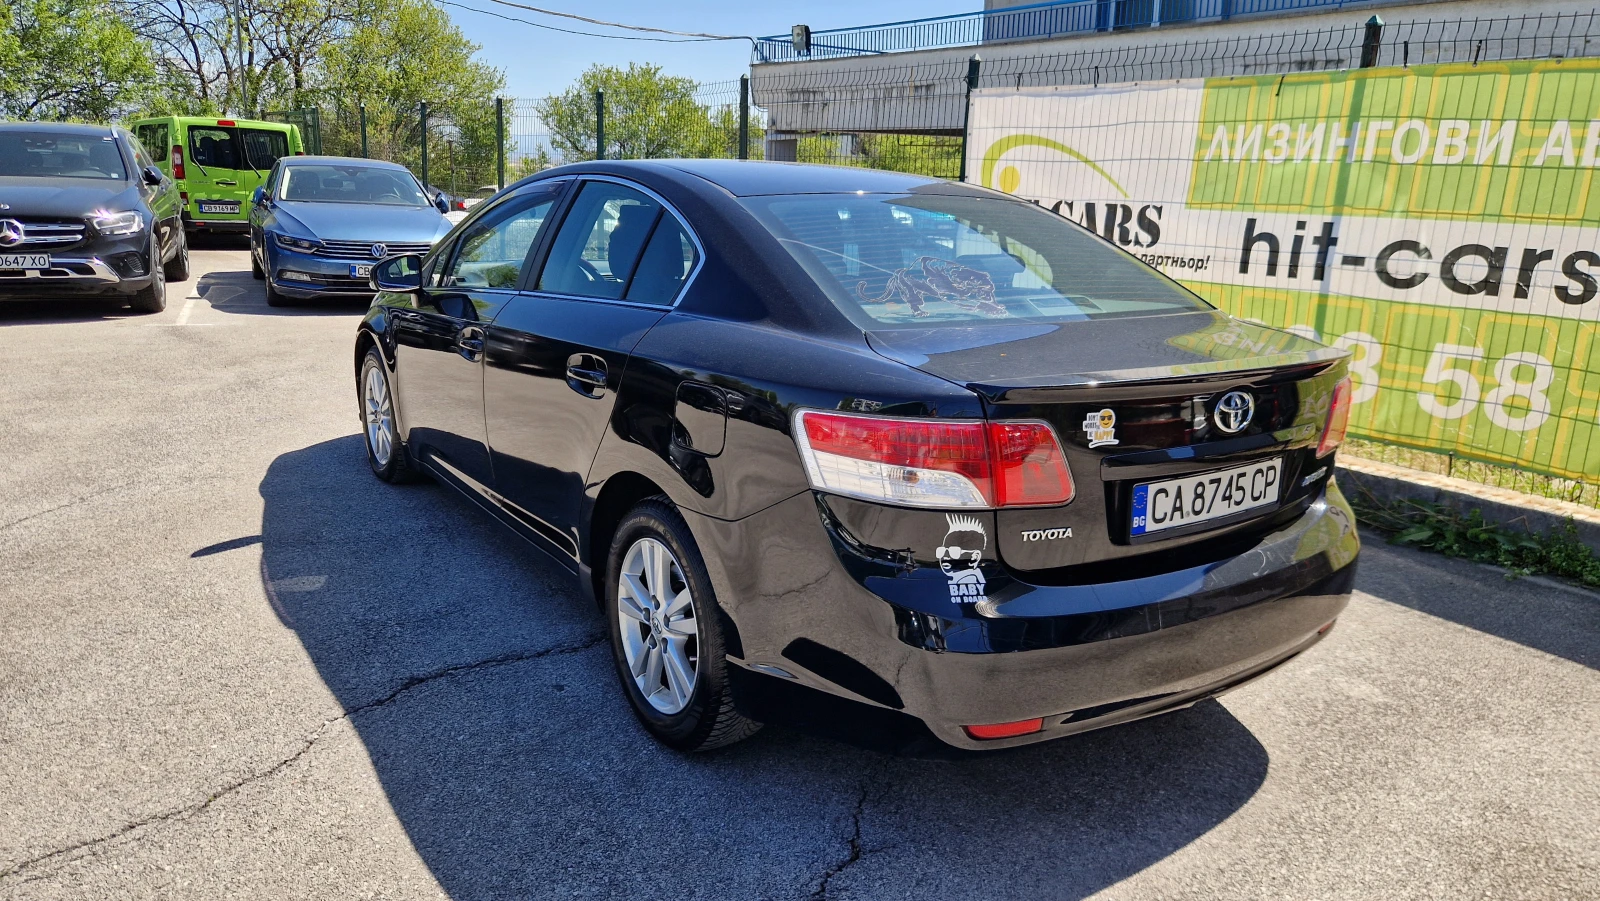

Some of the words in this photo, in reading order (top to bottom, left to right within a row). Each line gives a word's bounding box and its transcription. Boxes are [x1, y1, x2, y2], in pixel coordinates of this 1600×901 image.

[1203, 118, 1518, 166] ЛИЗИНГОВИ
[29, 256, 47, 267] XO
[1140, 253, 1211, 273] партньор!
[1237, 217, 1600, 307] hit-cars
[1416, 342, 1555, 431] 58
[1151, 485, 1184, 524] CA
[1191, 472, 1247, 517] 8745
[1250, 465, 1277, 502] CP
[1132, 516, 1146, 528] BG
[1021, 527, 1073, 542] TOYOTA
[949, 583, 985, 597] BABY
[950, 596, 961, 604] ON
[963, 595, 988, 604] BOARD
